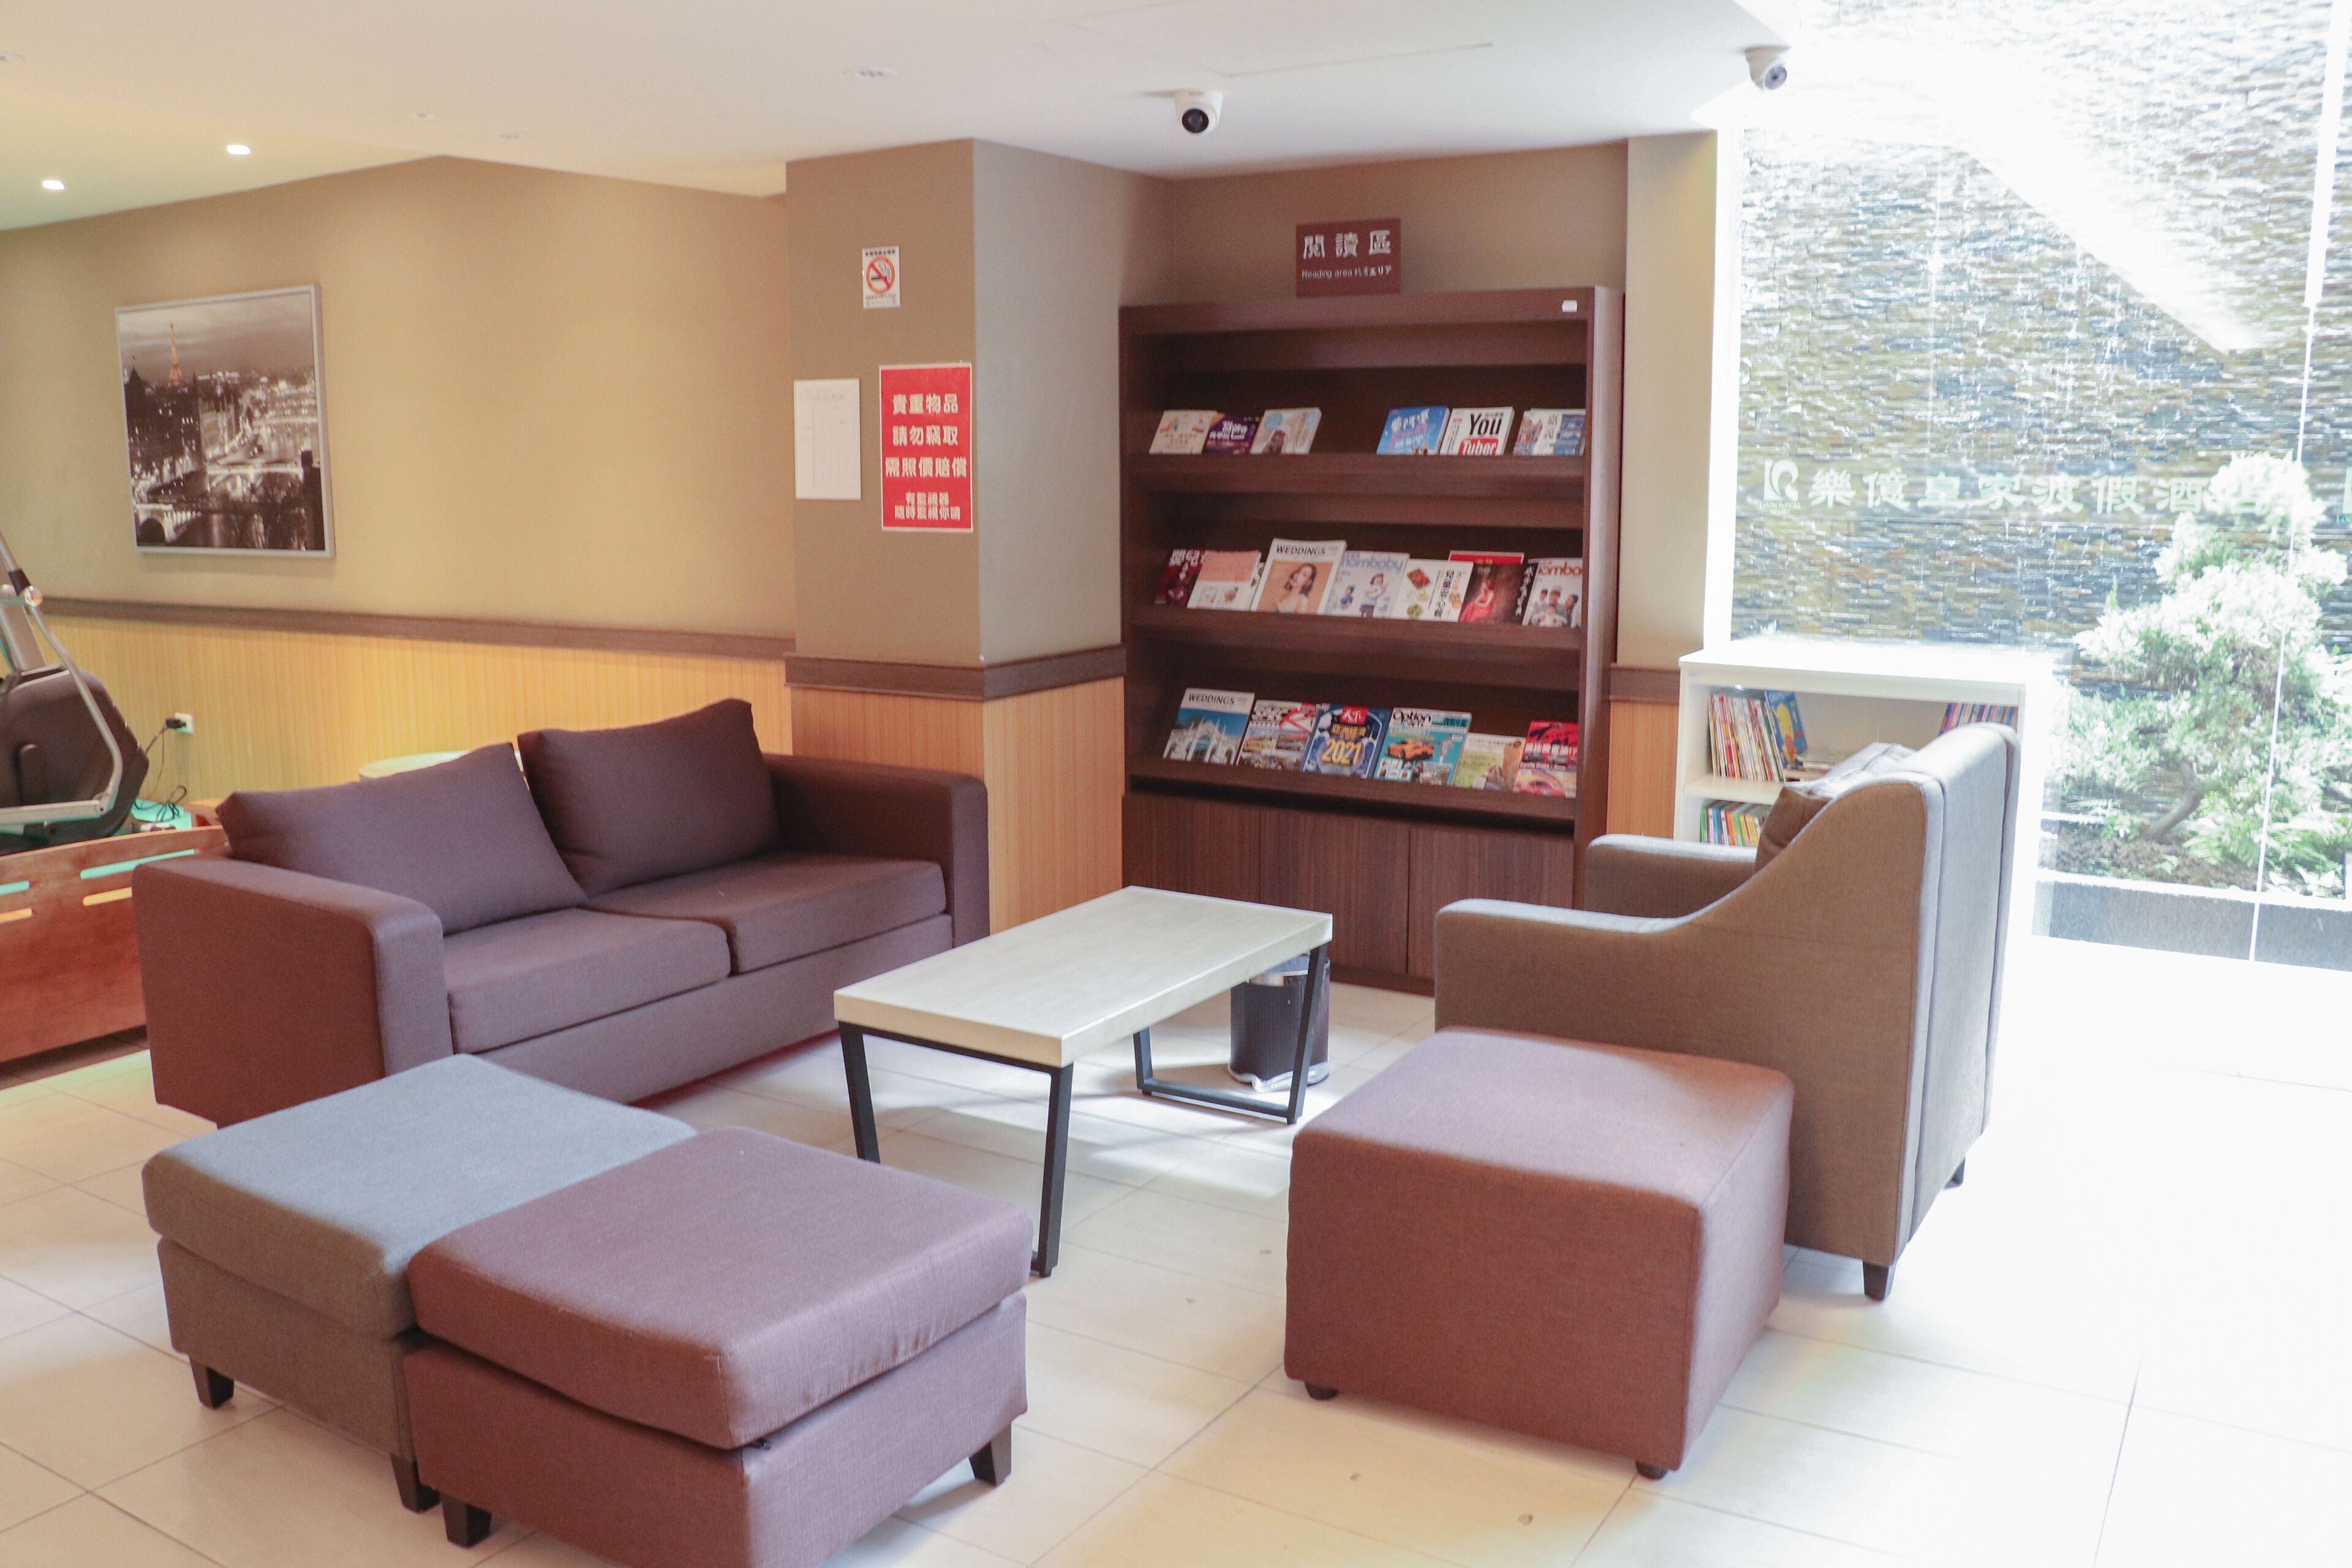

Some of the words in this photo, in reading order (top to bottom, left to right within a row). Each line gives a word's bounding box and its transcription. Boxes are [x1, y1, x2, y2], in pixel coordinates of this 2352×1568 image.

[1303, 229, 1392, 260] 閱讀區
[1301, 270, 1332, 281] Reading
[1335, 268, 1352, 277] area
[892, 393, 959, 415] 貴重物品
[1469, 412, 1502, 436] You
[892, 424, 959, 447] 請勿竊取
[885, 456, 968, 478] 需照價賠償
[1808, 467, 2267, 515] 樂億皇家渡假酒
[1276, 544, 1326, 556] WEDDINGS
[1188, 693, 1235, 706] WEDDINGS
[1321, 738, 1363, 766] 2021
